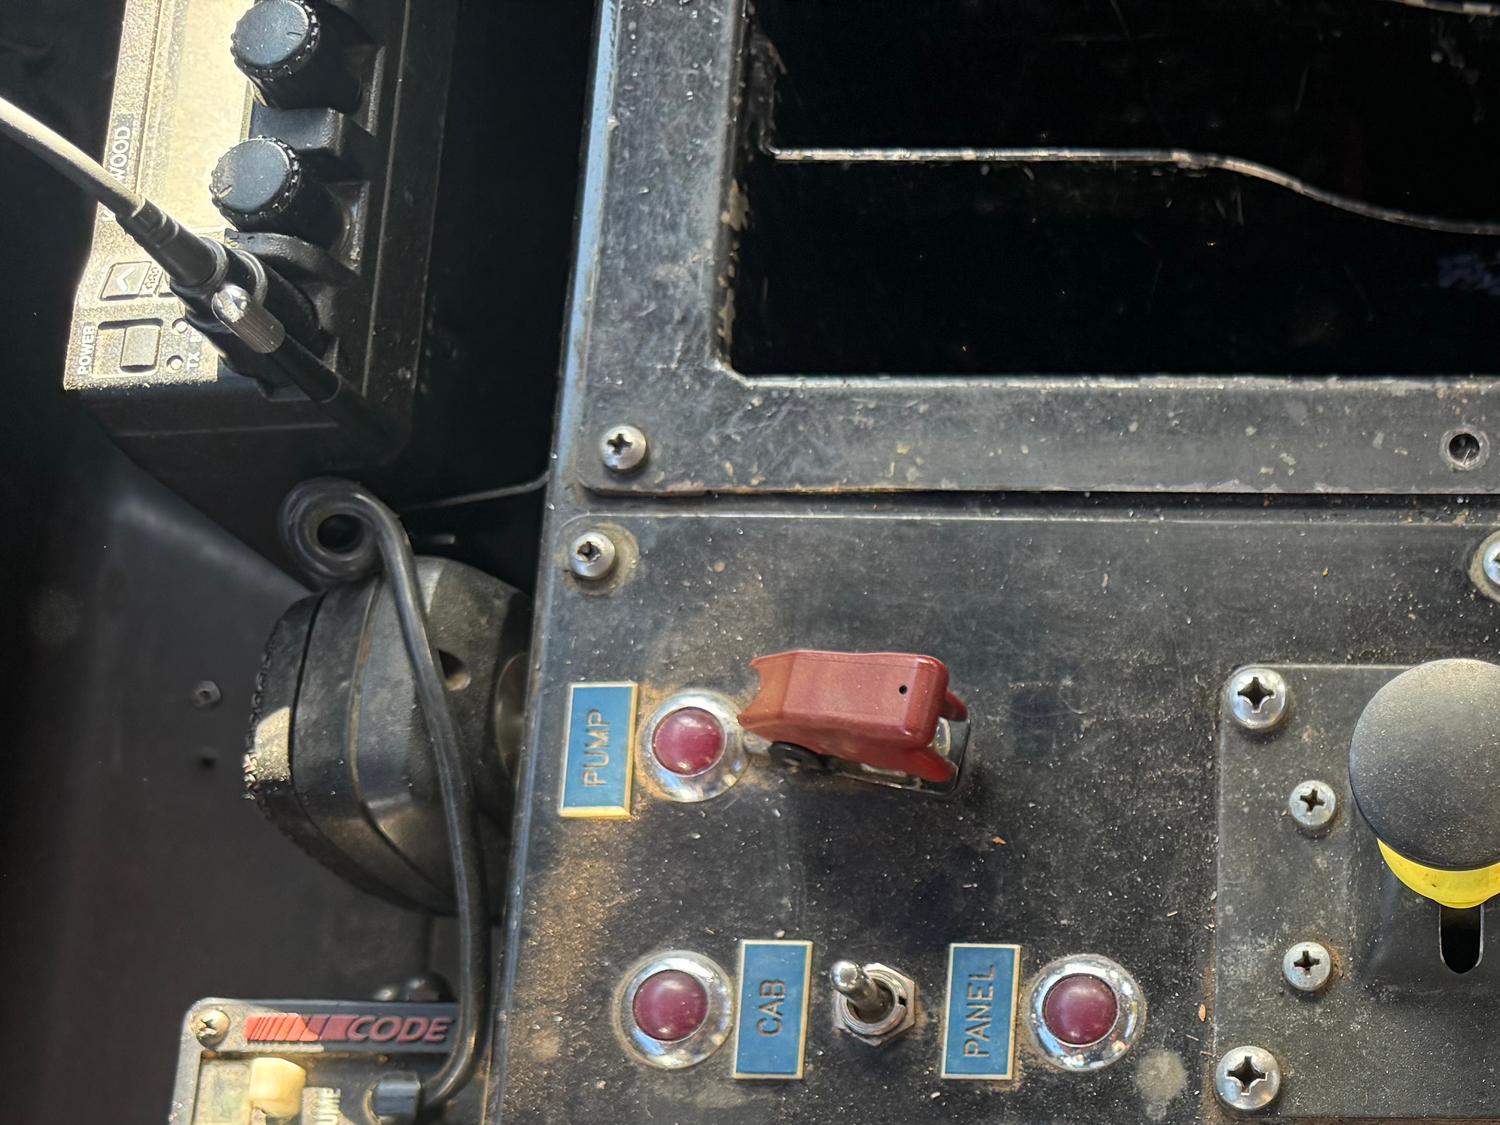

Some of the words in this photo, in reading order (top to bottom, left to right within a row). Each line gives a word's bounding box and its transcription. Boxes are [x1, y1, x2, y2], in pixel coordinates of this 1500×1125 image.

[78, 324, 96, 375] POWER
[187, 352, 200, 369] TX
[582, 709, 614, 788] PUMP
[345, 1014, 452, 1043] CODE
[755, 978, 786, 1038] CAB
[964, 963, 996, 1059] PANEL
